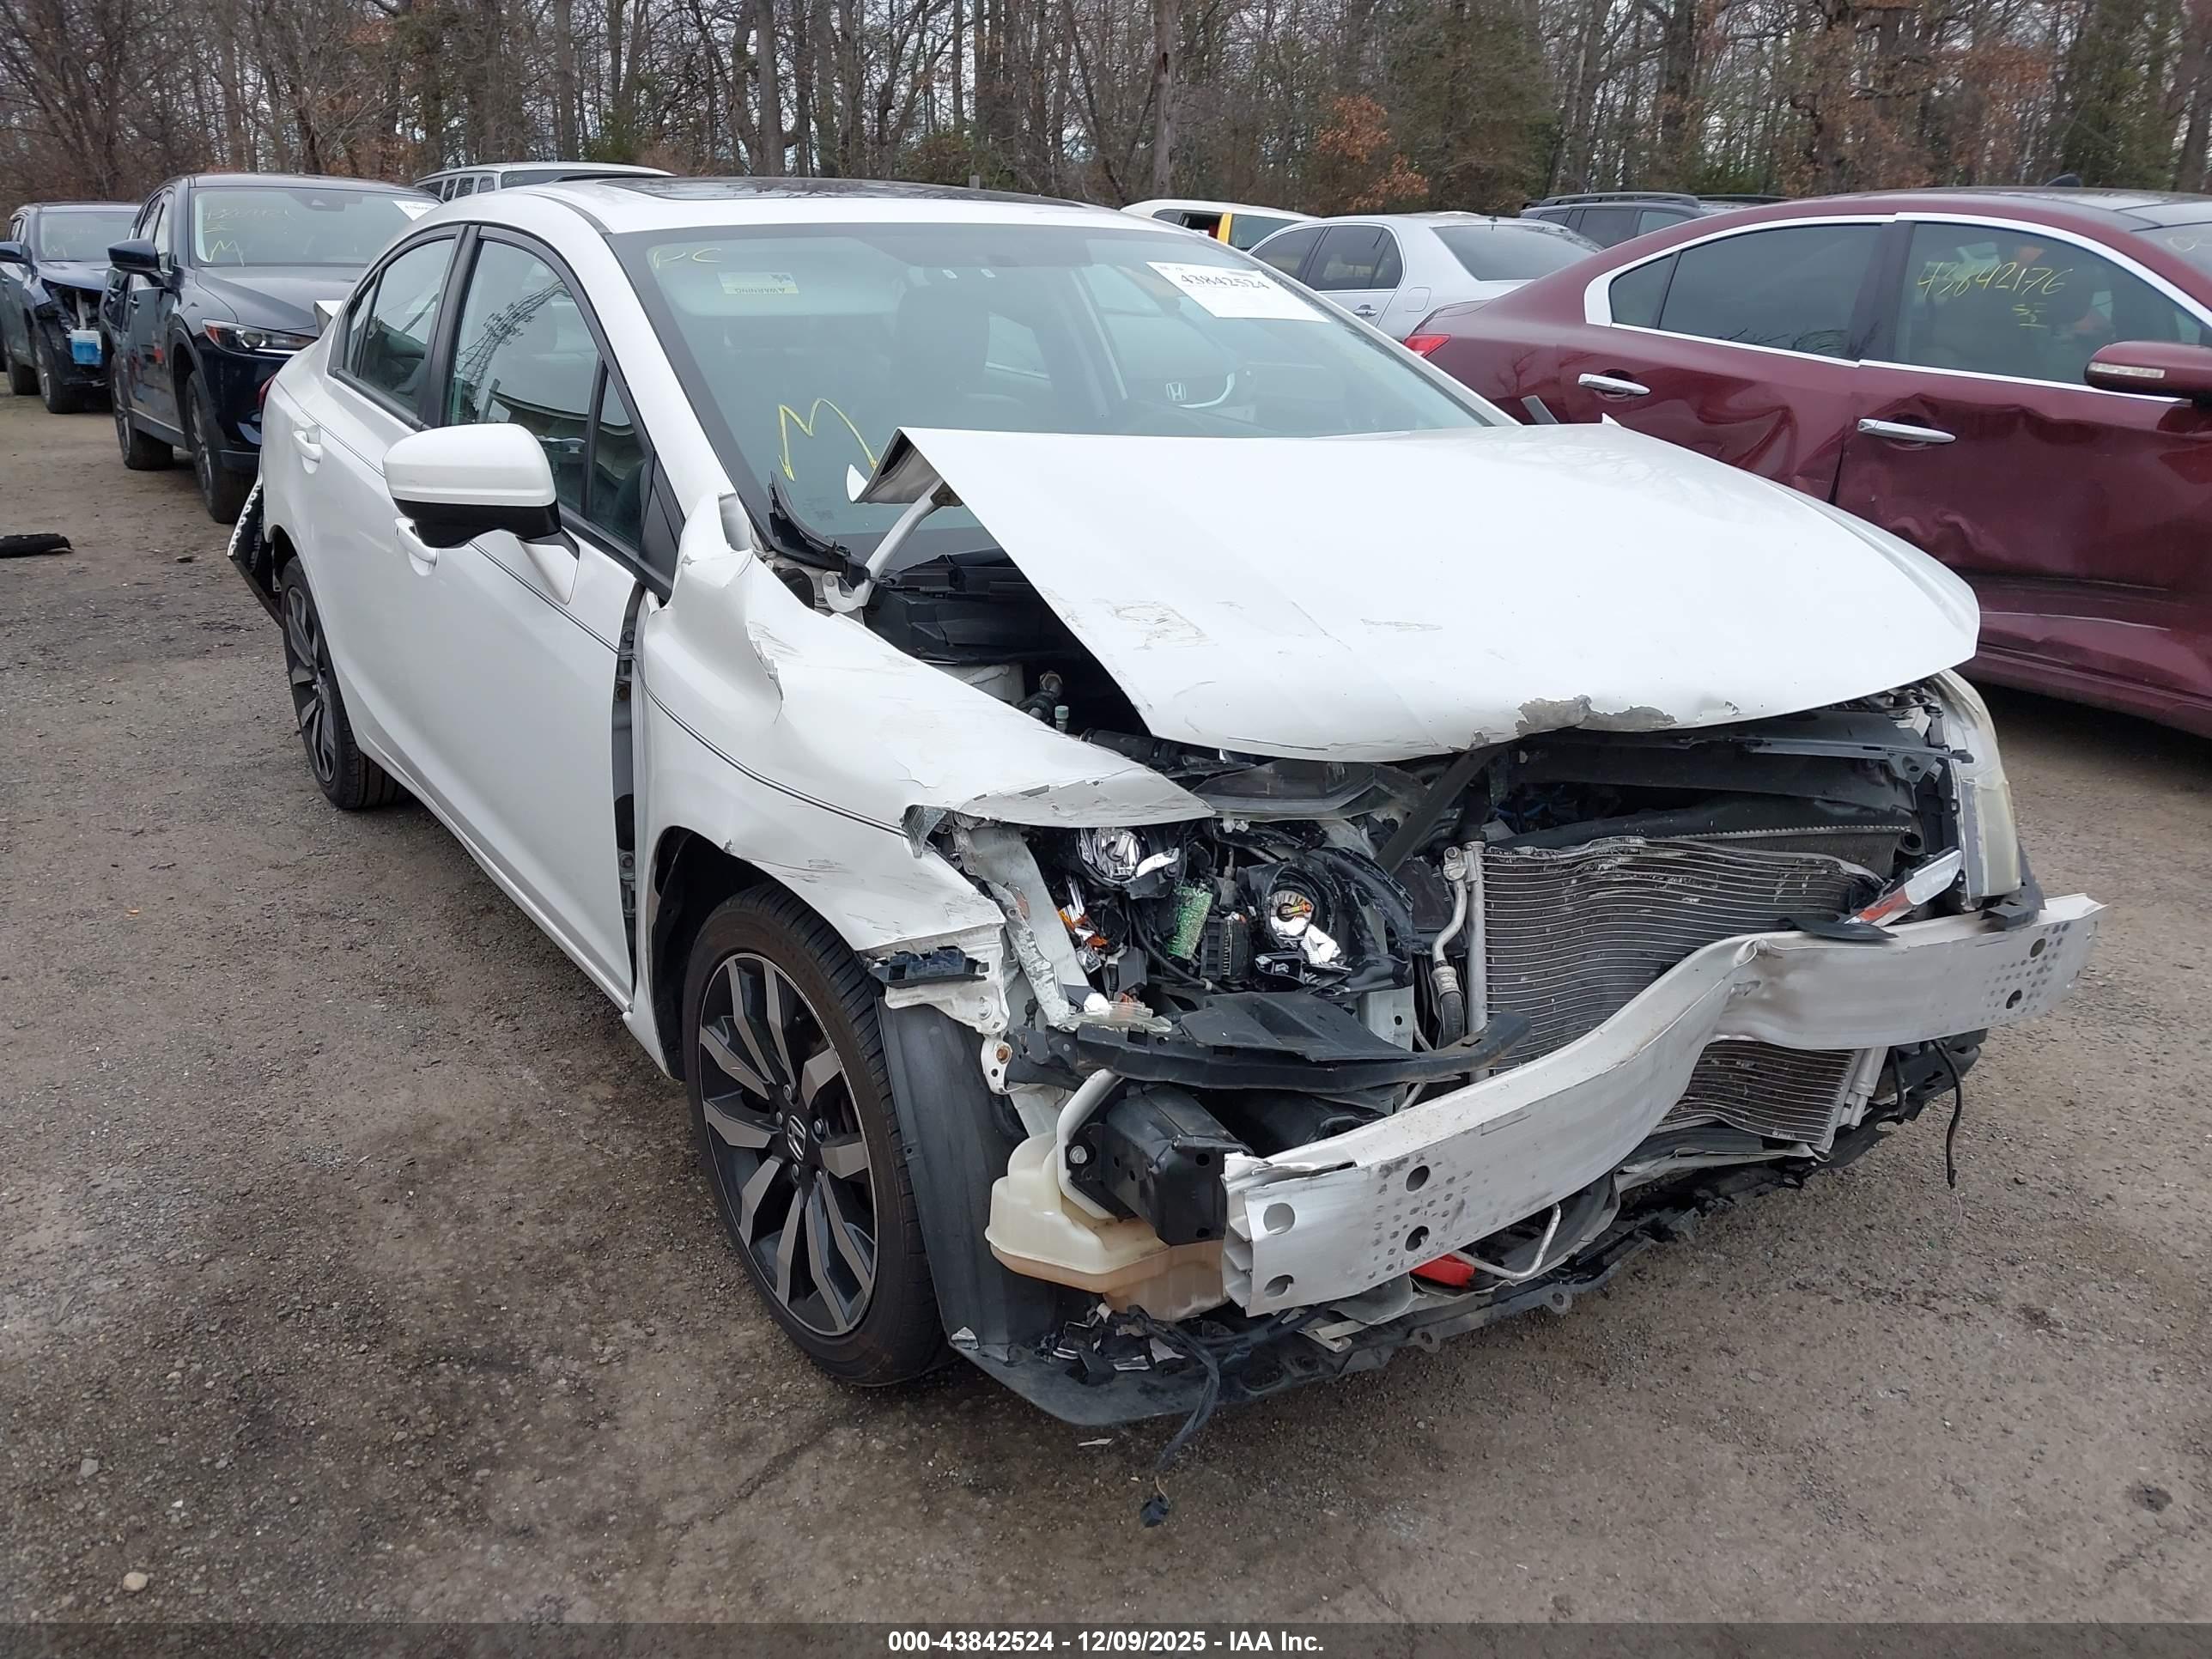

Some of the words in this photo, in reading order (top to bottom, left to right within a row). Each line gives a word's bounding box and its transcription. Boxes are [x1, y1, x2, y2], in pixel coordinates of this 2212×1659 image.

[207, 240, 245, 266] M
[1181, 274, 1271, 289] 43842524
[777, 398, 877, 482] M
